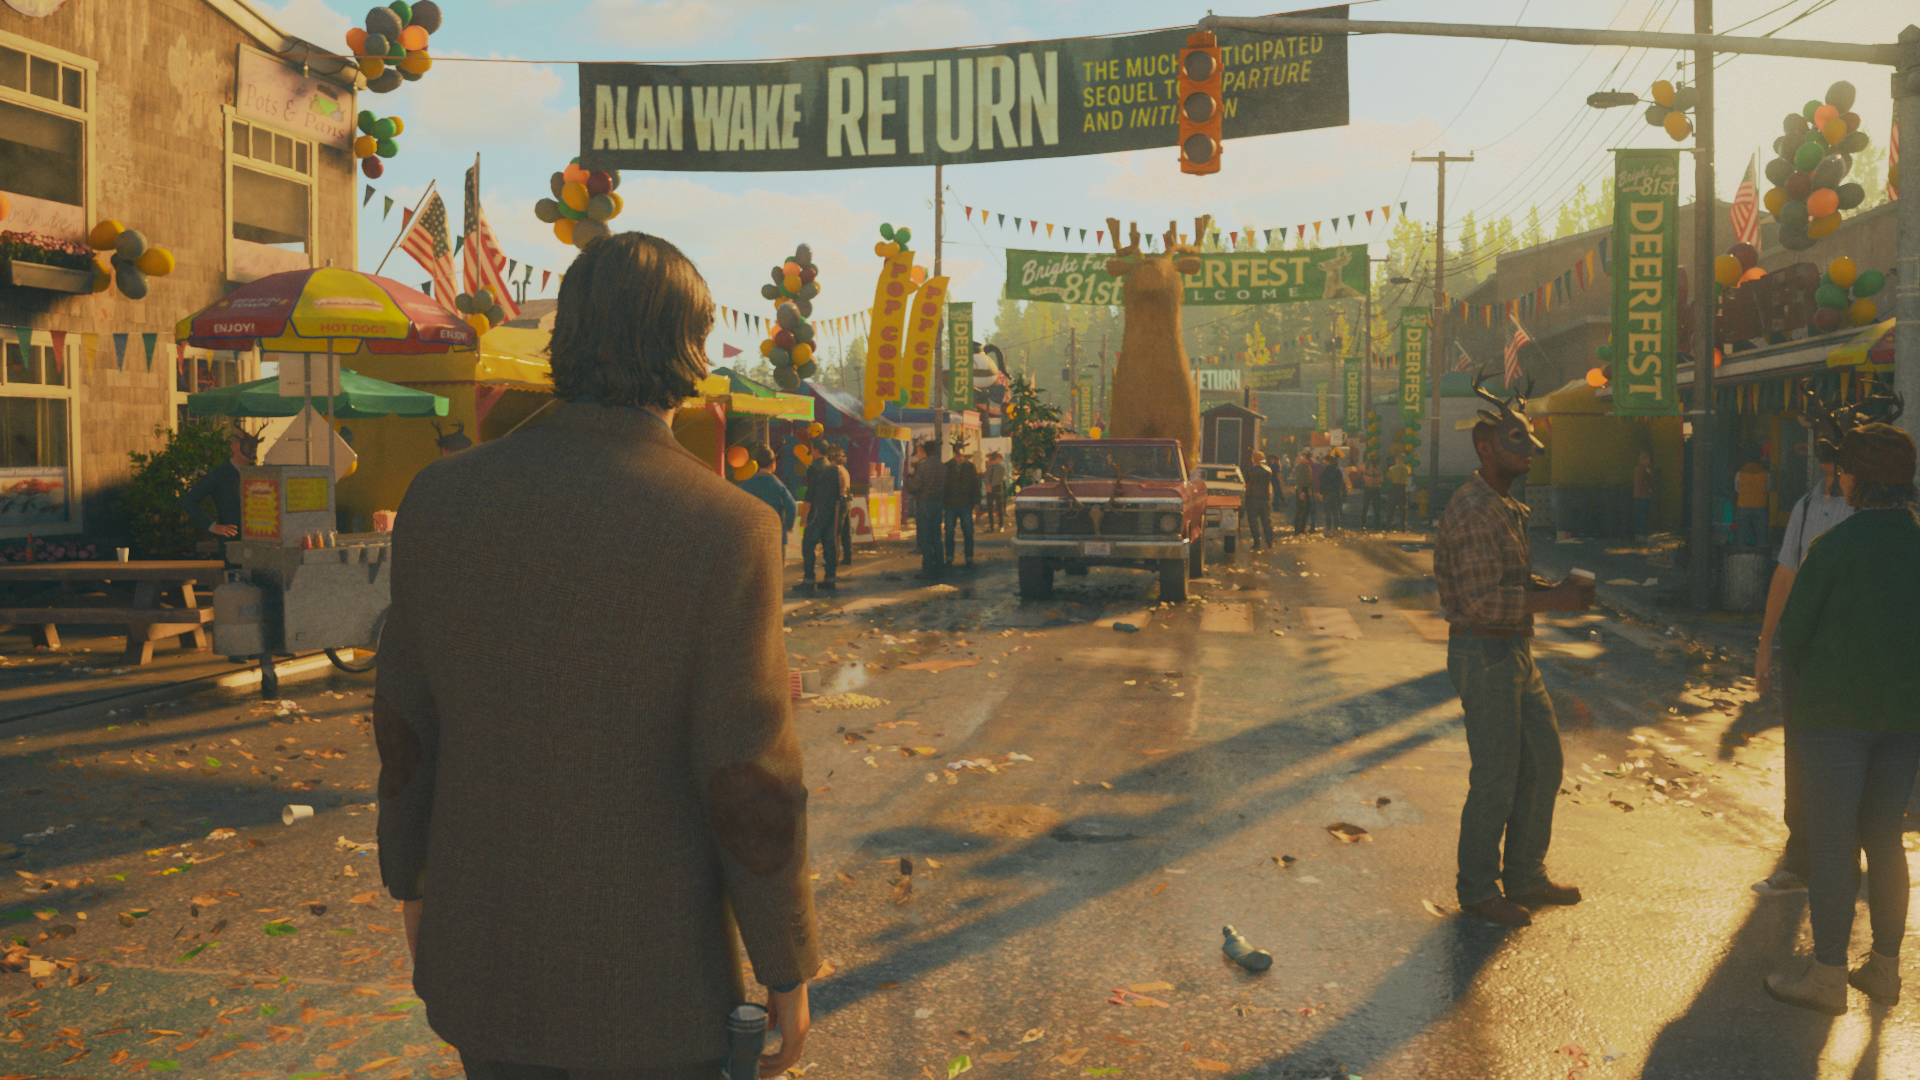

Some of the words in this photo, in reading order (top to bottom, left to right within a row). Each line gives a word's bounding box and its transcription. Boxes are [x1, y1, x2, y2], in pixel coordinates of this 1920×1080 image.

[1082, 59, 1119, 82] THE
[1221, 33, 1323, 67] TICIPATED
[593, 84, 653, 150] ALAN
[691, 83, 801, 151] WAKE
[827, 51, 1059, 157] RETURN
[1083, 82, 1159, 108] SEQUEL
[1221, 60, 1312, 92] PARTURE
[244, 83, 278, 116] Pots
[283, 99, 298, 122] &
[303, 111, 346, 139] Pans
[1083, 111, 1124, 133] AND
[1130, 97, 1238, 129] INITIN
[1640, 176, 1678, 196] 81st
[1022, 254, 1079, 286] Bright
[1082, 253, 1109, 272] Fal
[1061, 272, 1125, 305] 81st
[1184, 256, 1311, 289] ERFEST
[1194, 286, 1300, 301] LCOME
[1628, 201, 1665, 401] DEERFEST
[214, 322, 256, 334] ENJOY!
[320, 323, 350, 333] HOT
[351, 324, 388, 335] DOGS
[440, 329, 468, 341] ENJOY!
[953, 322, 969, 405] DEERFEST
[1404, 328, 1422, 413] DEERFEST
[1081, 386, 1091, 432] DEERFEST
[1347, 371, 1359, 428] DEERFEST
